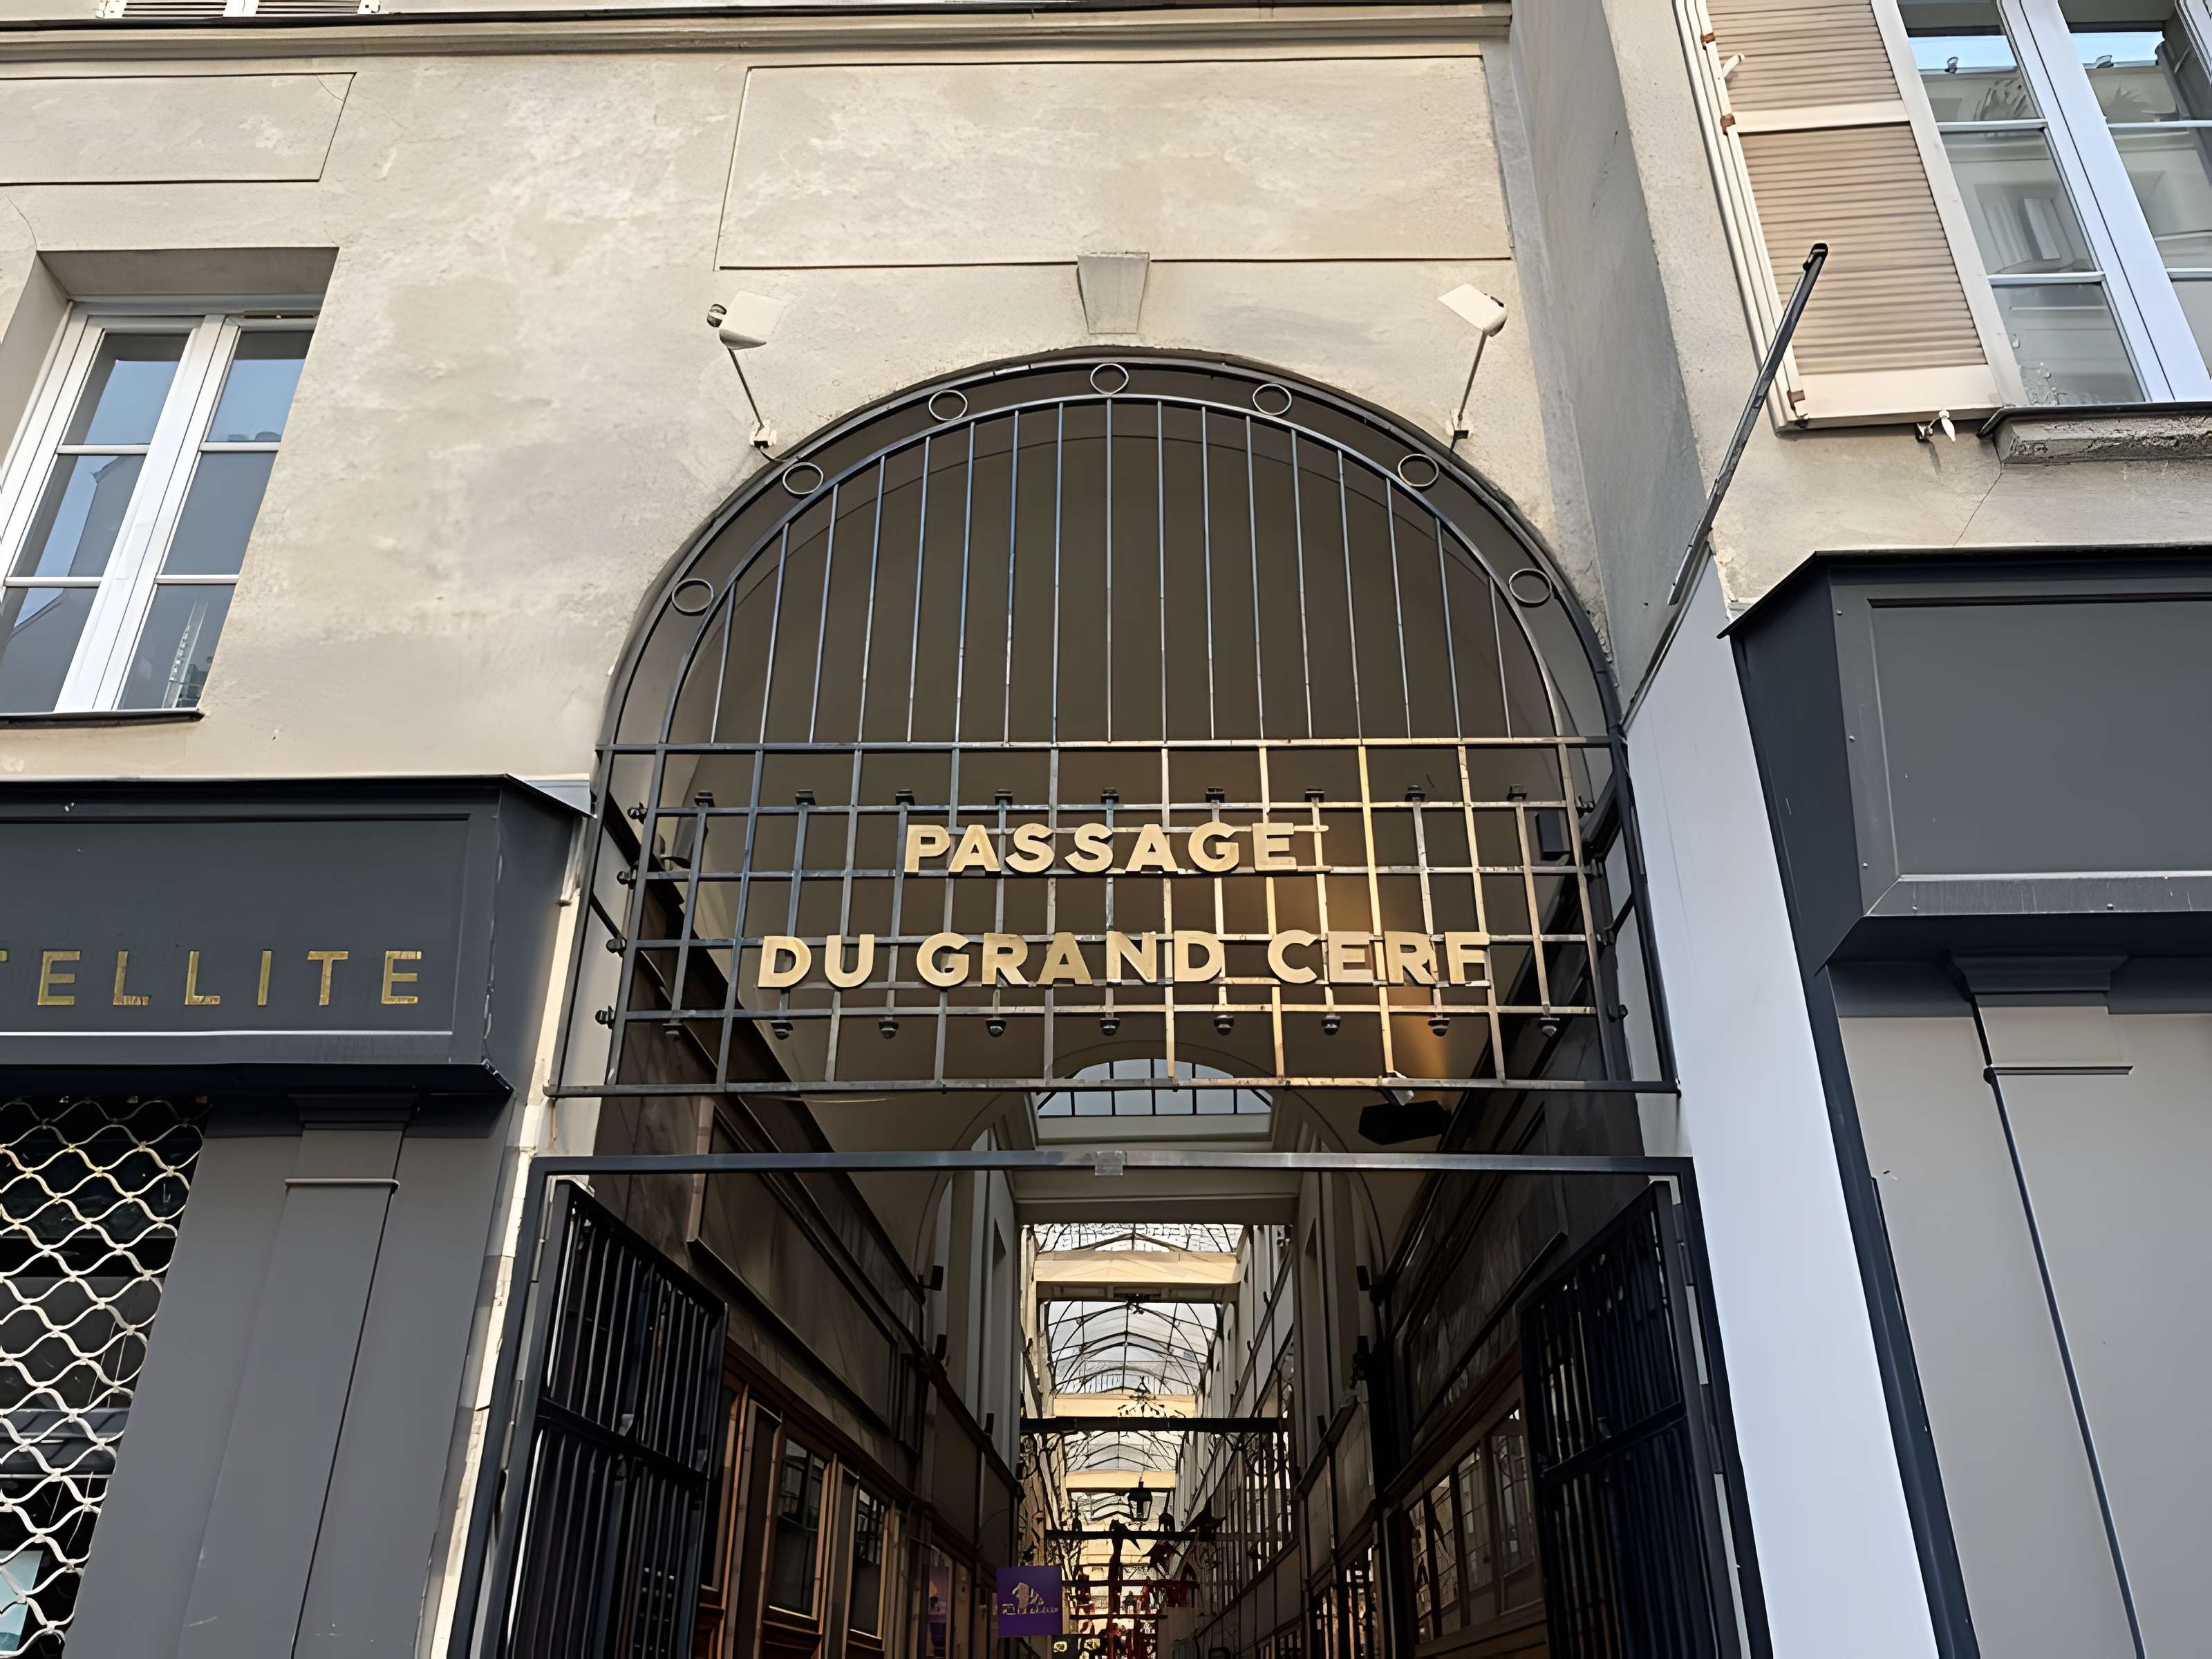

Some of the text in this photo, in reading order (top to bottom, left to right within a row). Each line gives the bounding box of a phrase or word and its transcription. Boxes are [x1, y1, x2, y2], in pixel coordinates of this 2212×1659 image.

[904, 821, 1297, 874] PASSAGE
[0, 950, 422, 1006] ELLITE
[758, 929, 1490, 988] DU GRAND CERF
